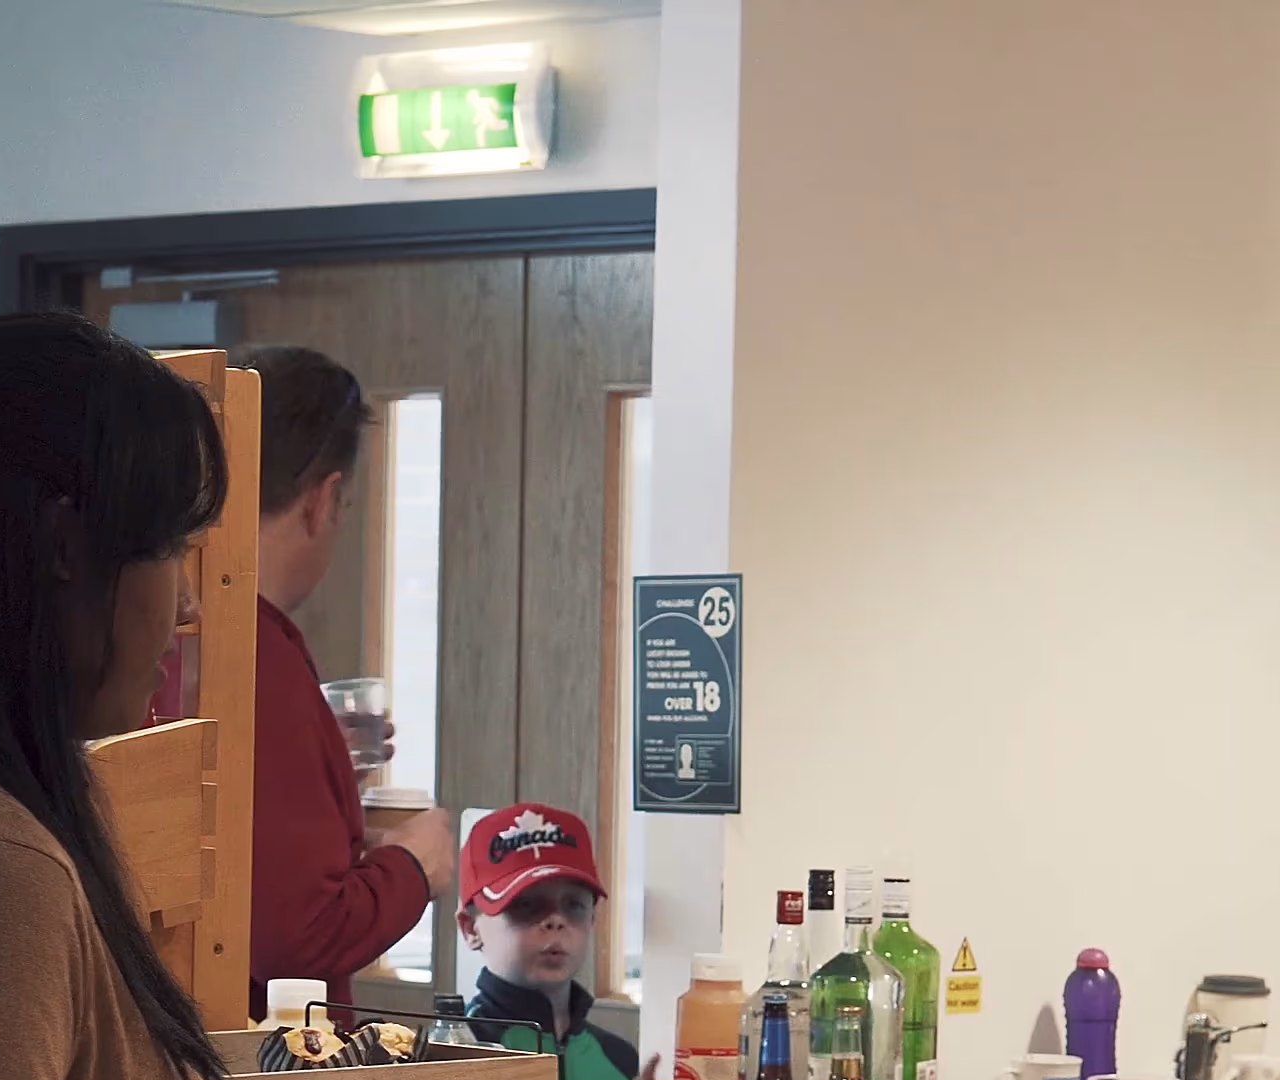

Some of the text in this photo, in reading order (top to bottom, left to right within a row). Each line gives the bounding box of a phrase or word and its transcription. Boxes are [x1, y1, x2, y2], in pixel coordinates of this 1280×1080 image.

[703, 596, 731, 627] 25
[664, 697, 693, 711] OVER
[692, 681, 721, 713] 18
[487, 826, 578, 864] Canada
